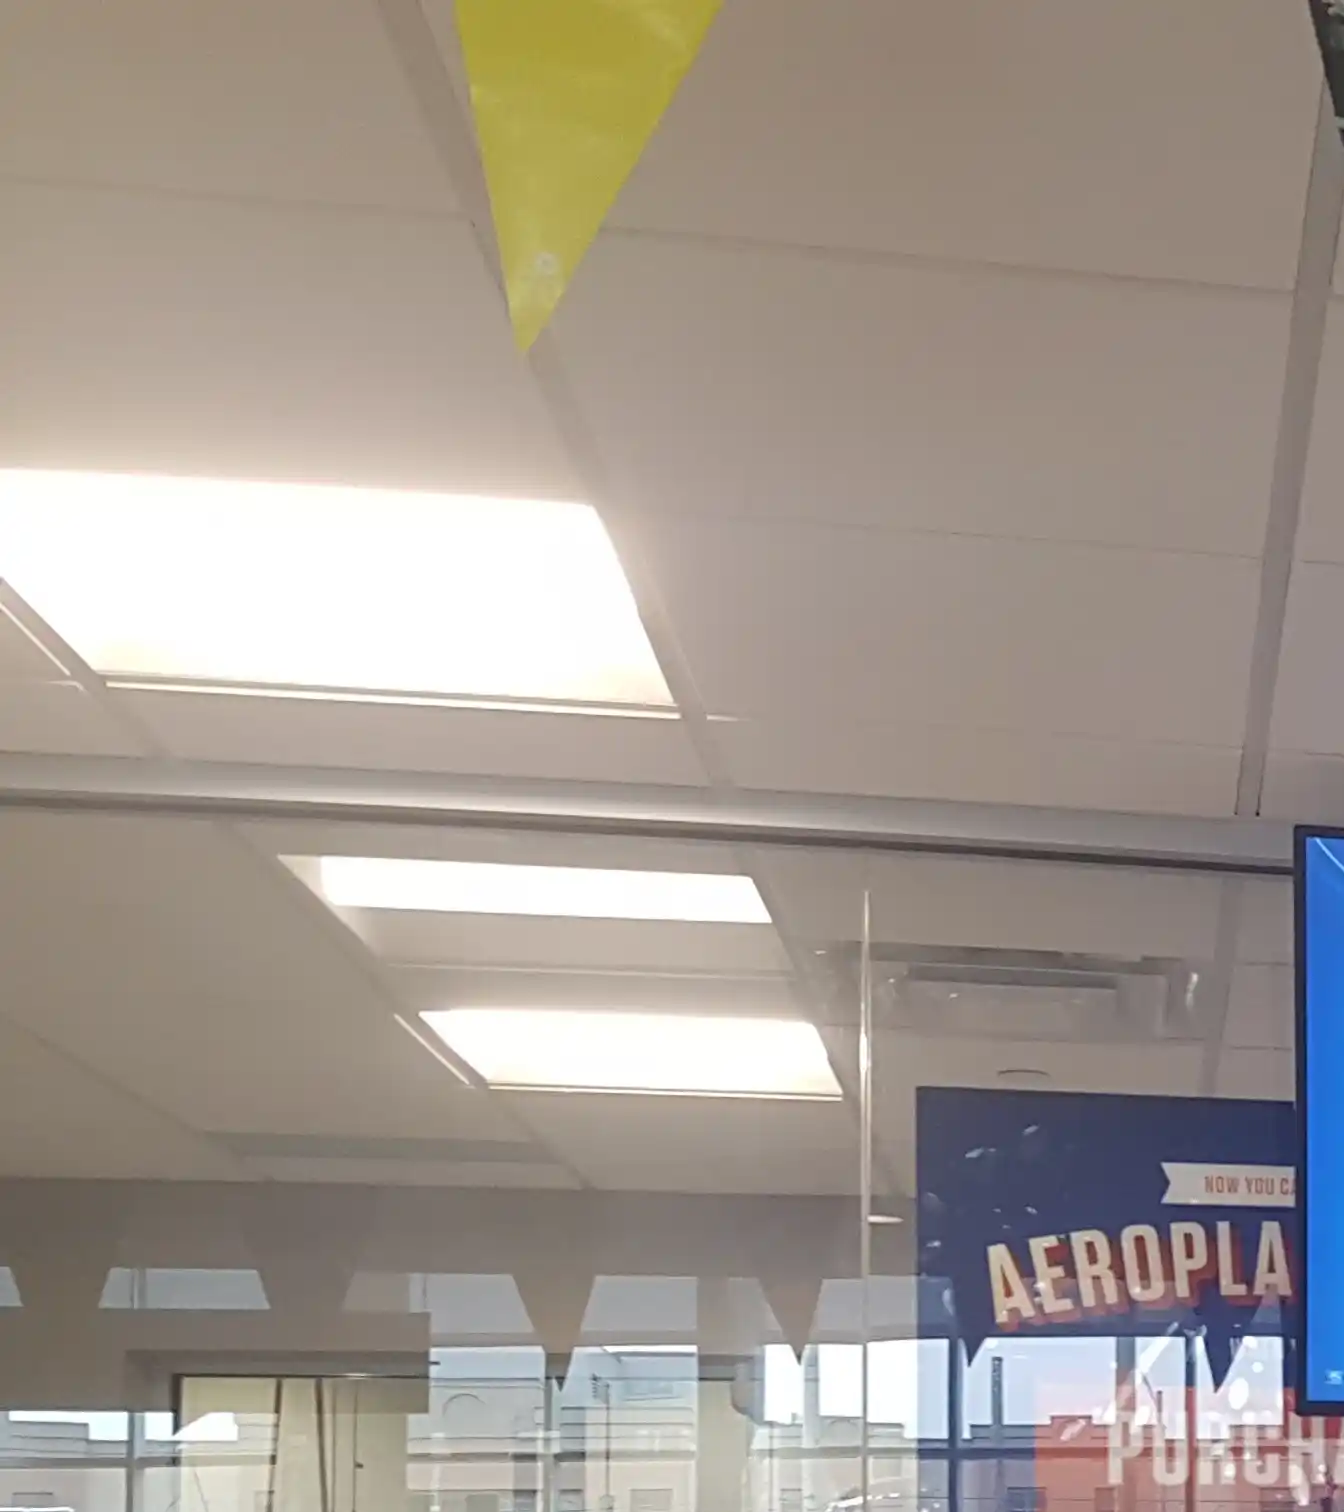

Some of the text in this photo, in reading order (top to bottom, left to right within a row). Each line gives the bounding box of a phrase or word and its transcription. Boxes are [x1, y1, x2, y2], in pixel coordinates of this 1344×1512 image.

[1204, 1175, 1240, 1194] NOW
[1245, 1176, 1276, 1195] YOU
[987, 1220, 1294, 1325] AEROPLA
